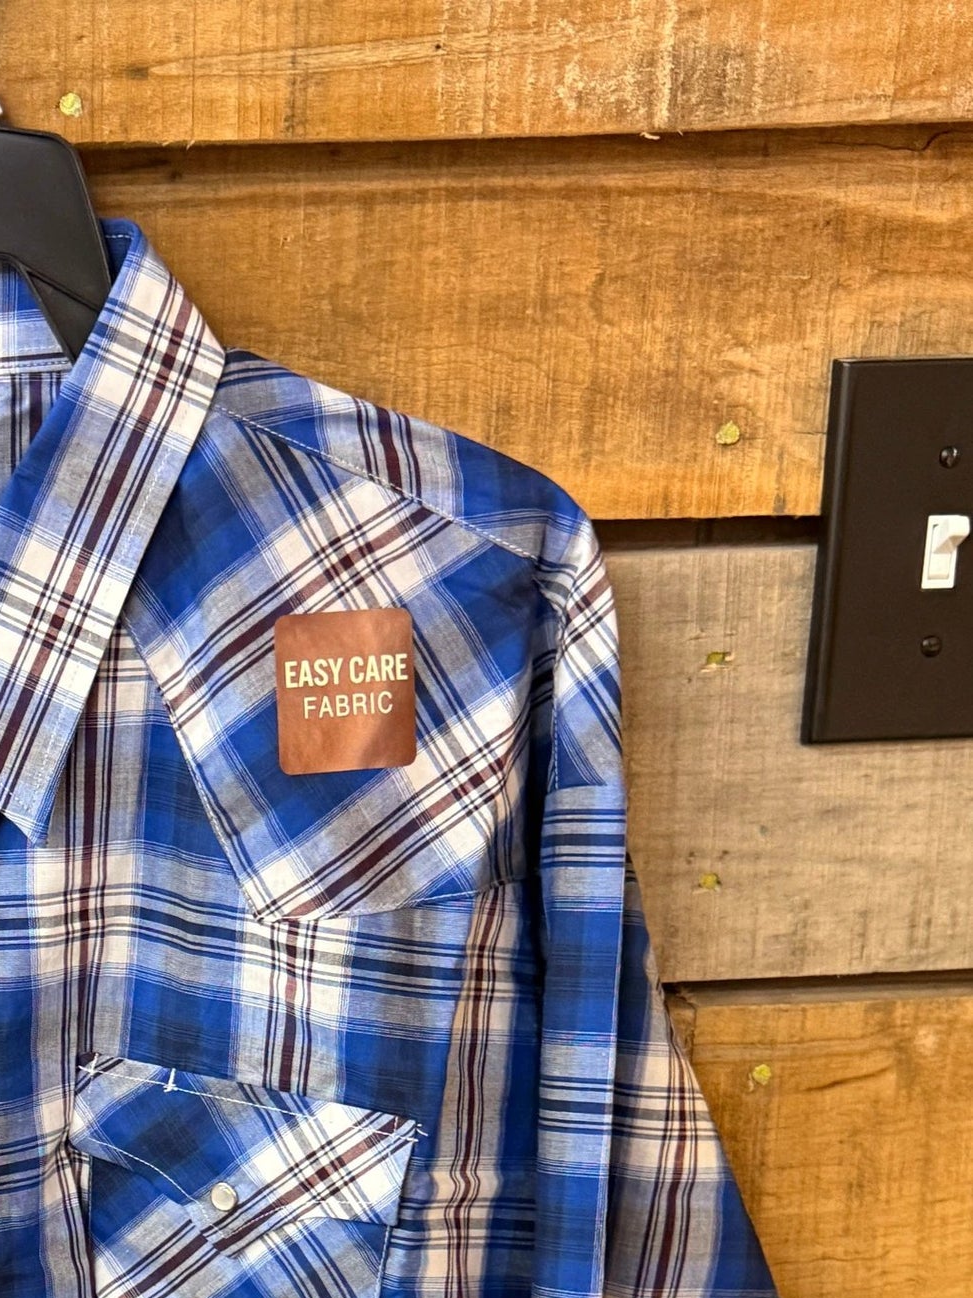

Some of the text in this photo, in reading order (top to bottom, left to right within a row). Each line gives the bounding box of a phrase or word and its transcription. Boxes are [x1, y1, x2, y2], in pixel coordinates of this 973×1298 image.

[284, 653, 409, 689] EASY CARE
[303, 690, 393, 719] FABRIC
